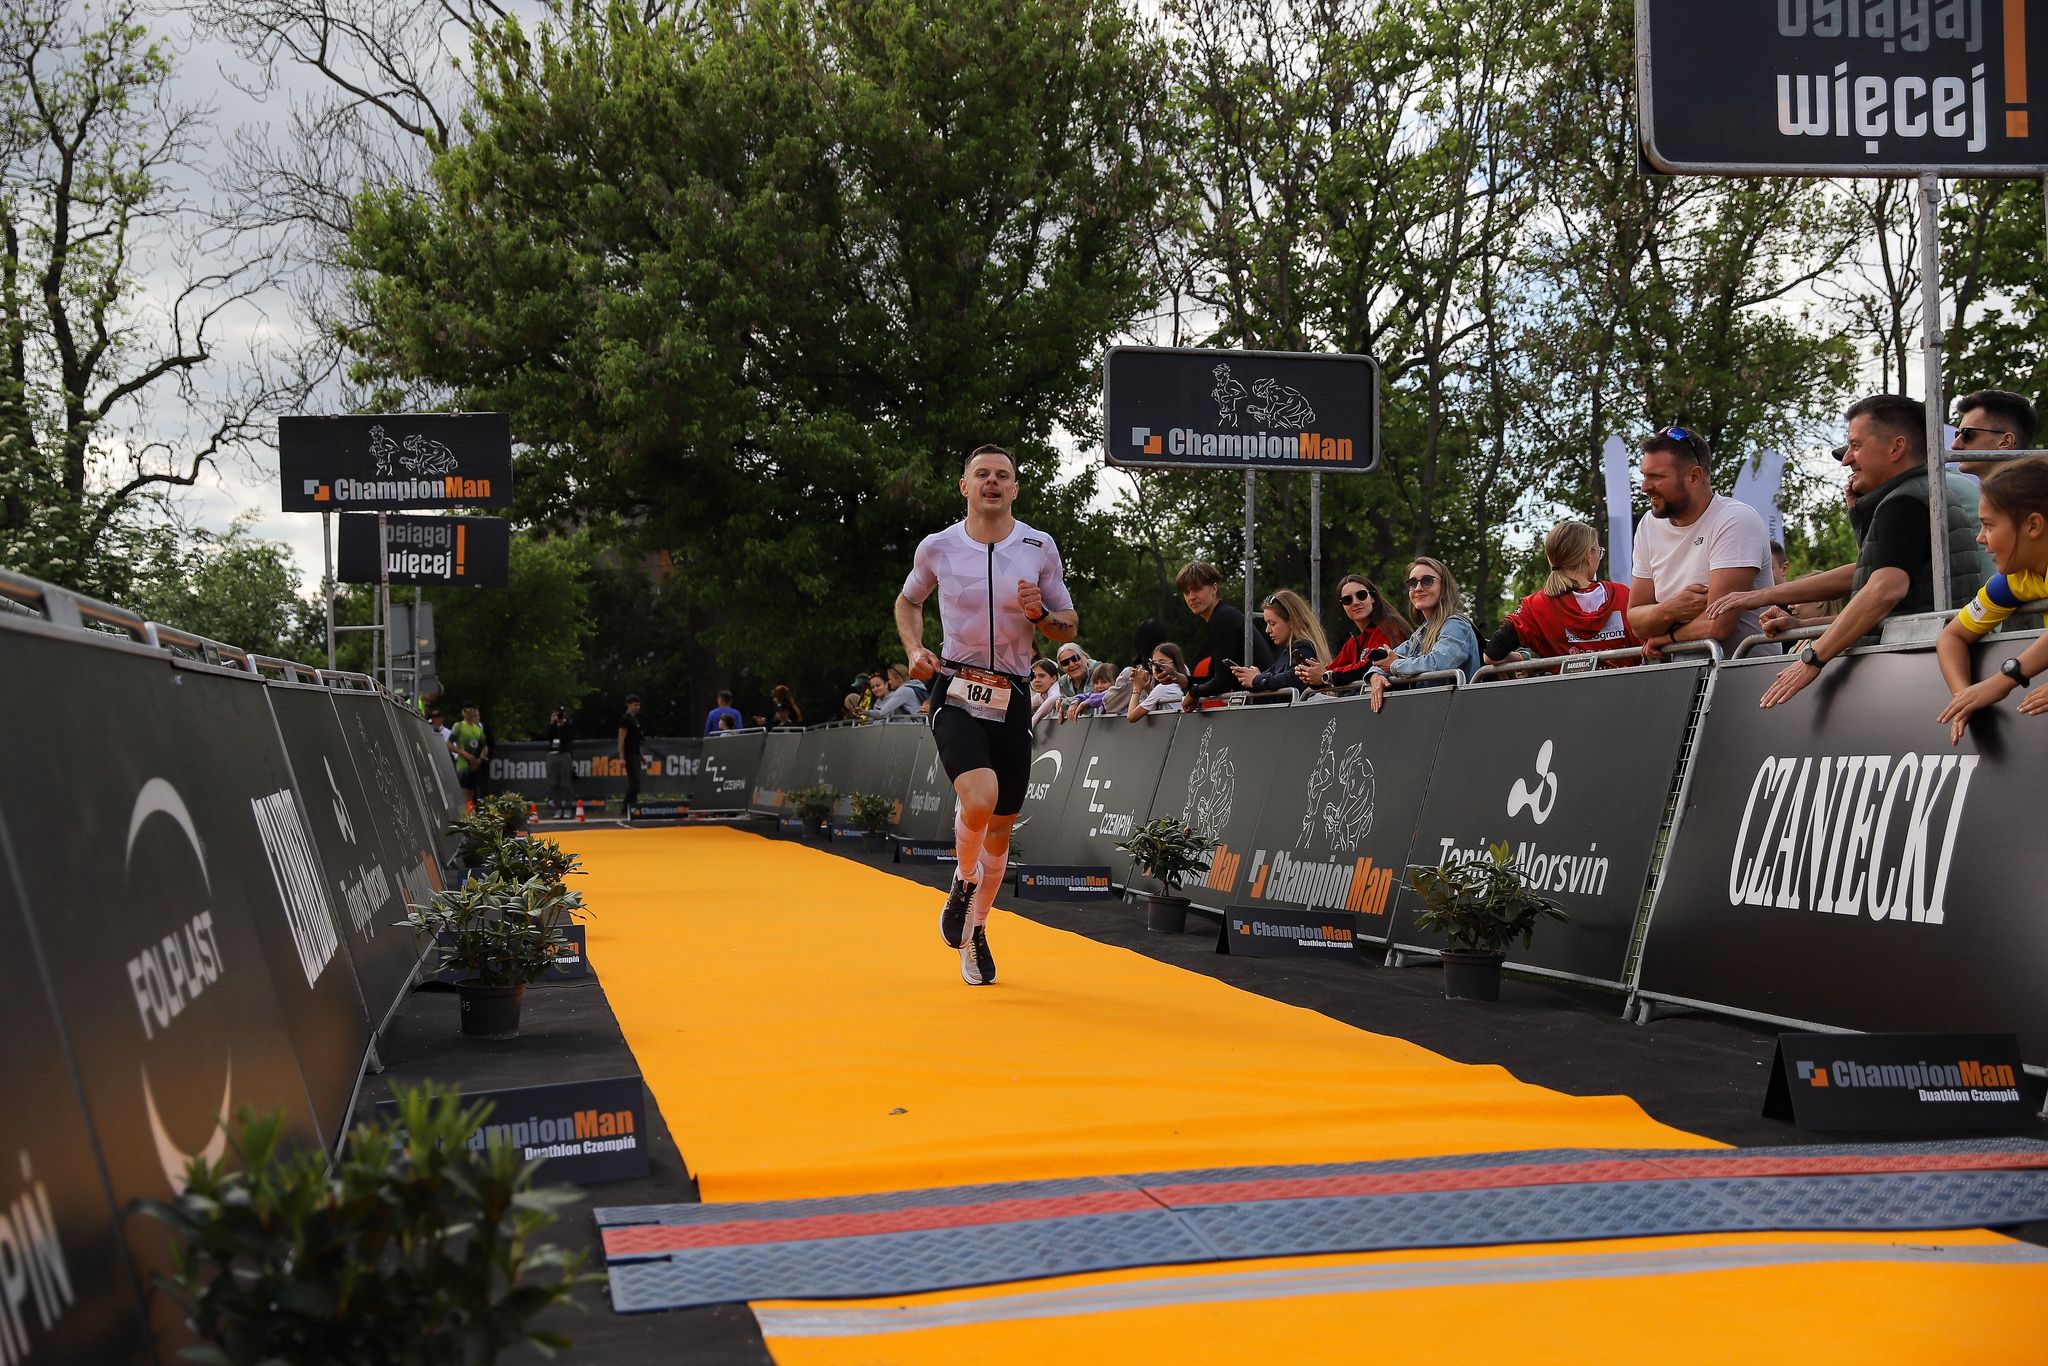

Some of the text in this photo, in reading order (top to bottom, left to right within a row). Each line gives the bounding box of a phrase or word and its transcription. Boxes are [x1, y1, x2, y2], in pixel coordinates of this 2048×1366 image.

[1776, 61, 1987, 154] więcej
[1168, 427, 1353, 461] ChampionMan
[334, 475, 492, 502] ChampionMan
[966, 683, 993, 704] 184
[1025, 782, 1051, 800] PLAST
[1729, 751, 1981, 925] CZANIECKI
[1036, 874, 1109, 887] ChampionMan
[1265, 849, 1394, 916] ChampionMan
[1252, 921, 1353, 941] ChampionMan
[127, 909, 224, 1041] FOLPLAST
[1831, 1060, 2016, 1090] ChampionMan
[1918, 1088, 2020, 1102] Duathlon Czempiń
[583, 1135, 637, 1155] Czempiń
